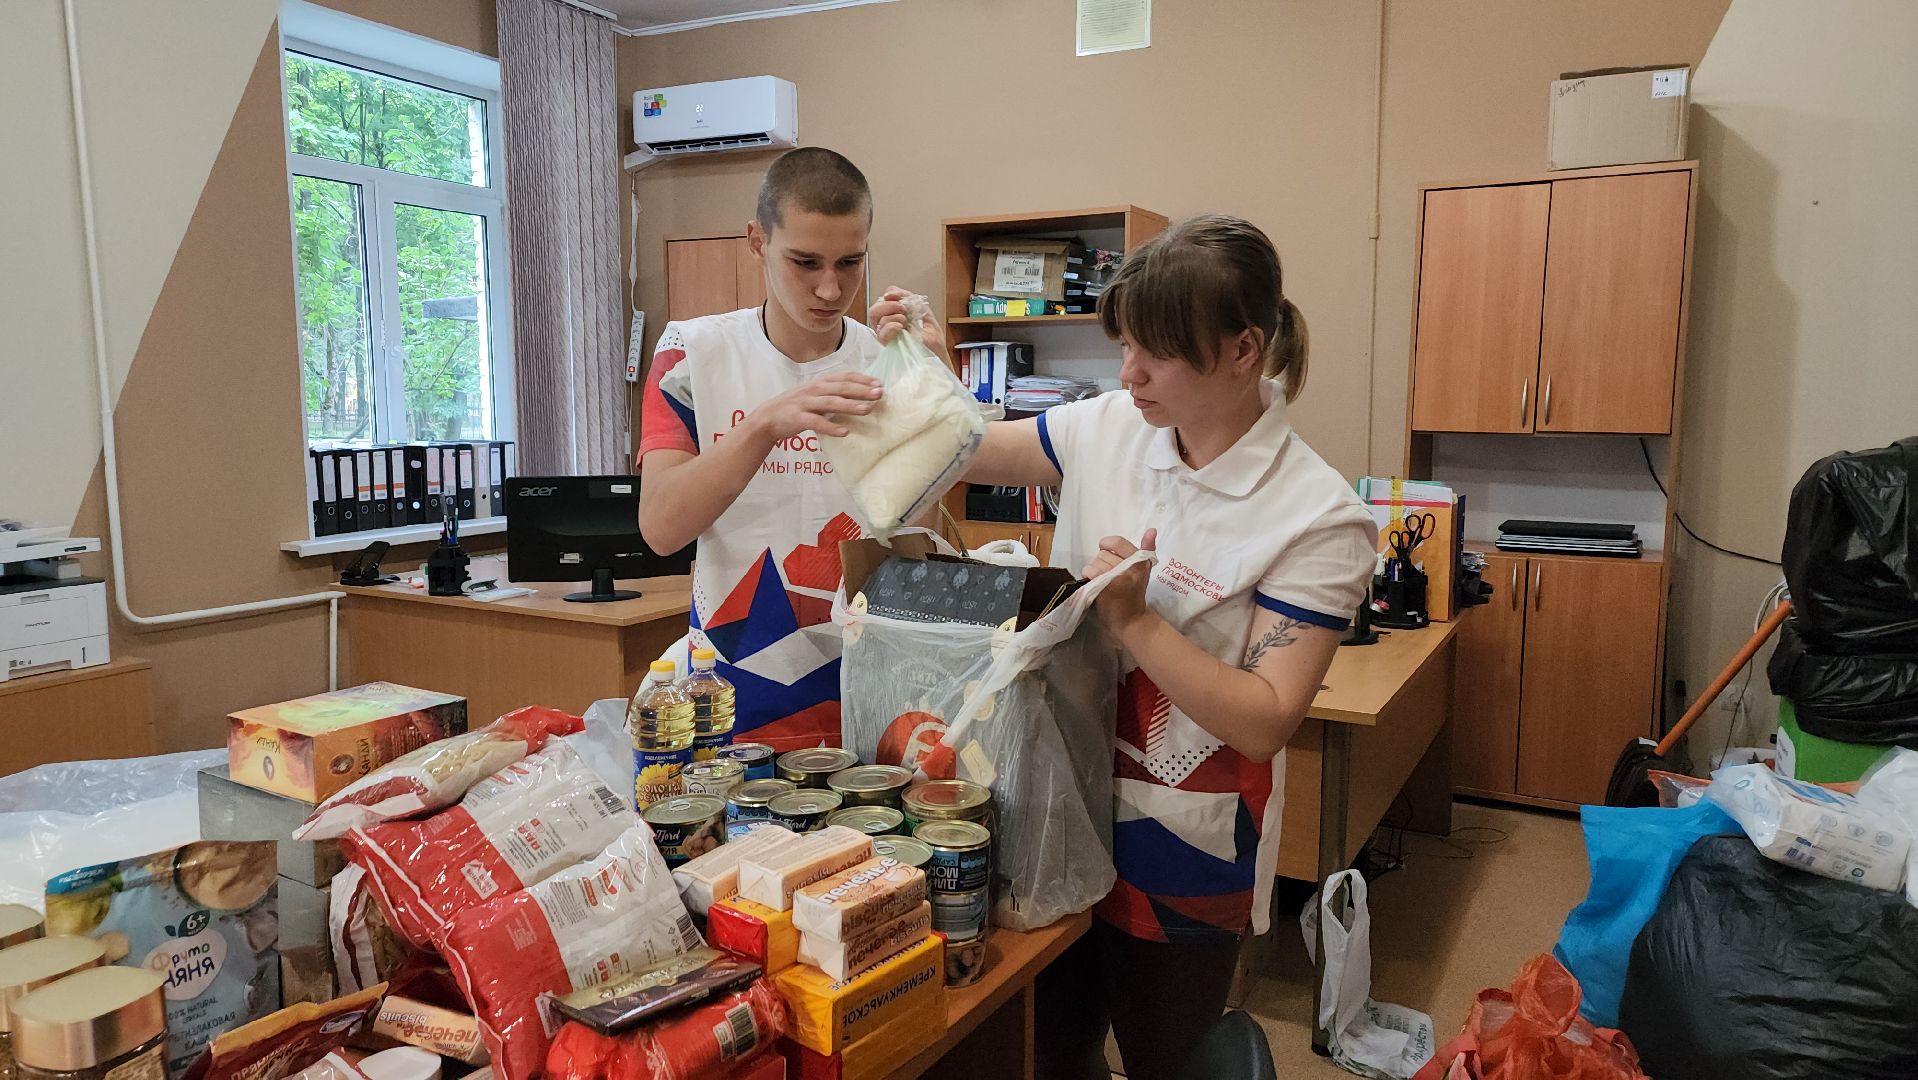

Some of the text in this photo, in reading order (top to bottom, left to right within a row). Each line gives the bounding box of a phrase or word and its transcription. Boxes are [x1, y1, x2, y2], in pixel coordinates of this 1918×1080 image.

[762, 461, 834, 477] МЫ РЯДО
[518, 485, 559, 497] acer
[1168, 557, 1225, 591] ВОЛОНТЕРЫ
[1162, 566, 1224, 602] ПОДМОСКОВЬ
[817, 856, 899, 905] печенье
[186, 914, 206, 930] 6+
[380, 1011, 427, 1025] biscuits
[403, 1021, 479, 1043] печенье
